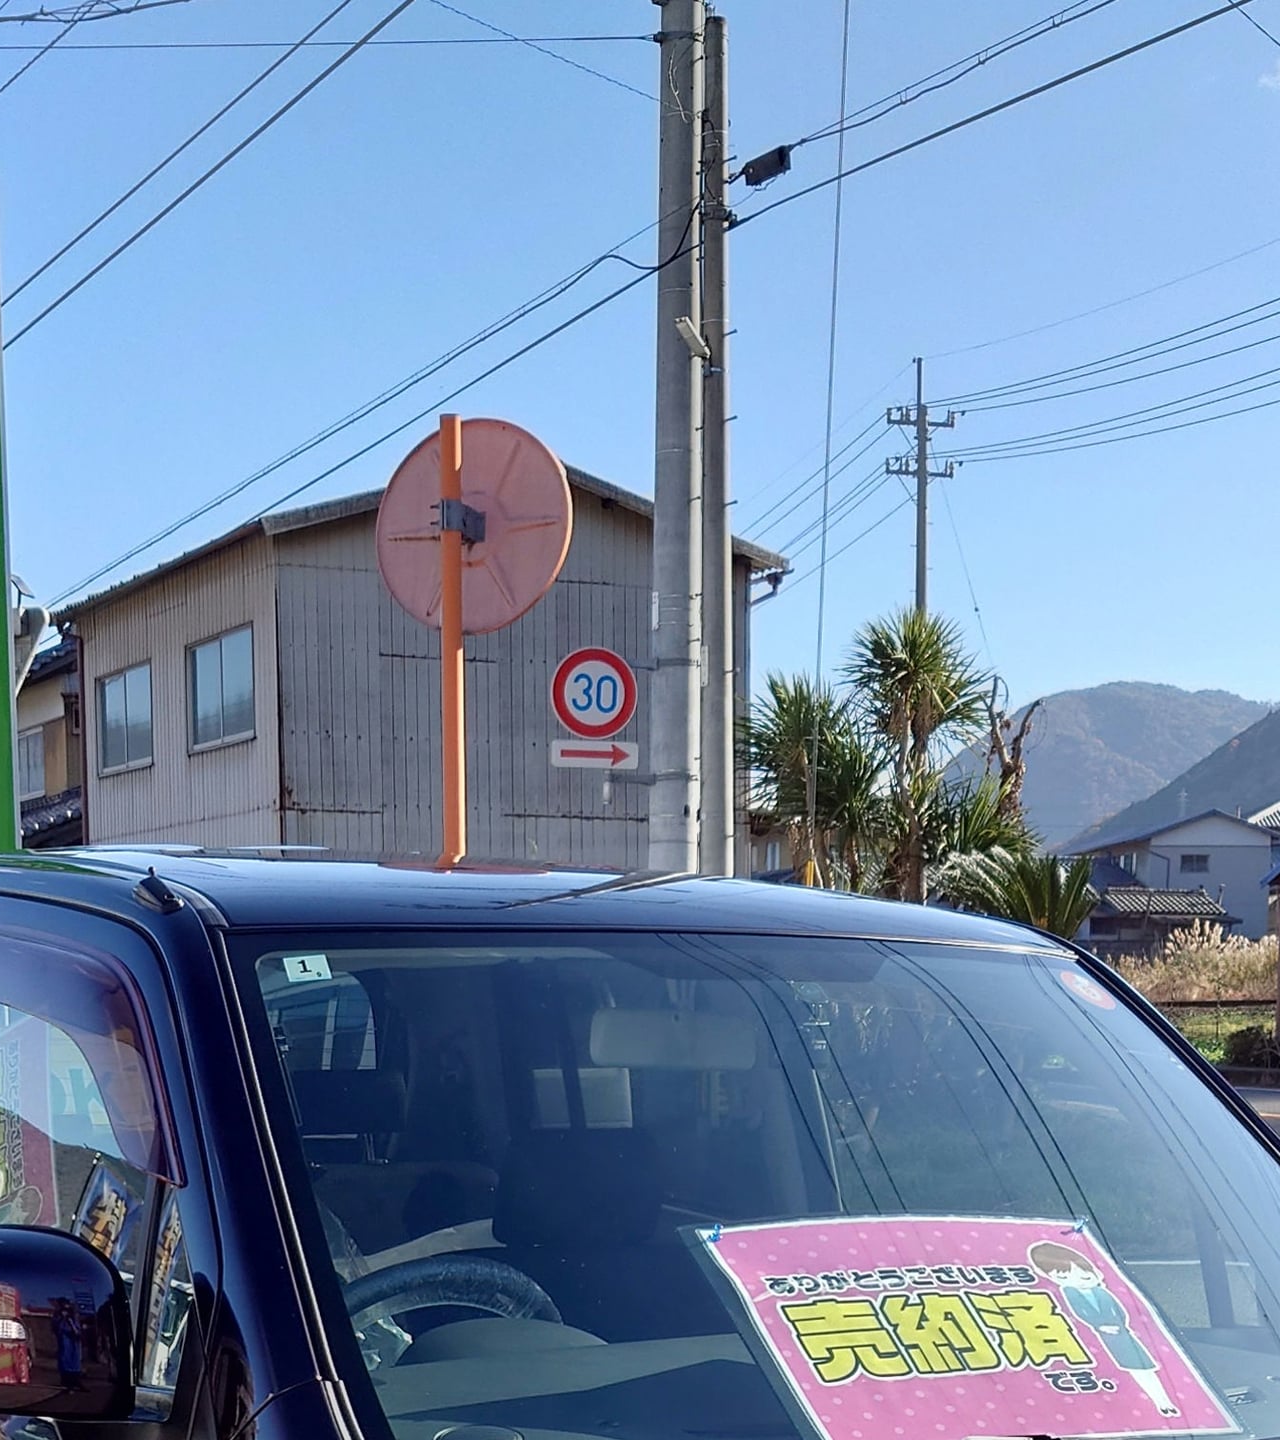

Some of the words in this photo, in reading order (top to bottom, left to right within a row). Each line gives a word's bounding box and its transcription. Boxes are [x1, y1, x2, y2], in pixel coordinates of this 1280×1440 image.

[571, 673, 618, 713] 30
[766, 1266, 1037, 1294] ありがとうございます
[780, 1290, 1093, 1383] 売約済
